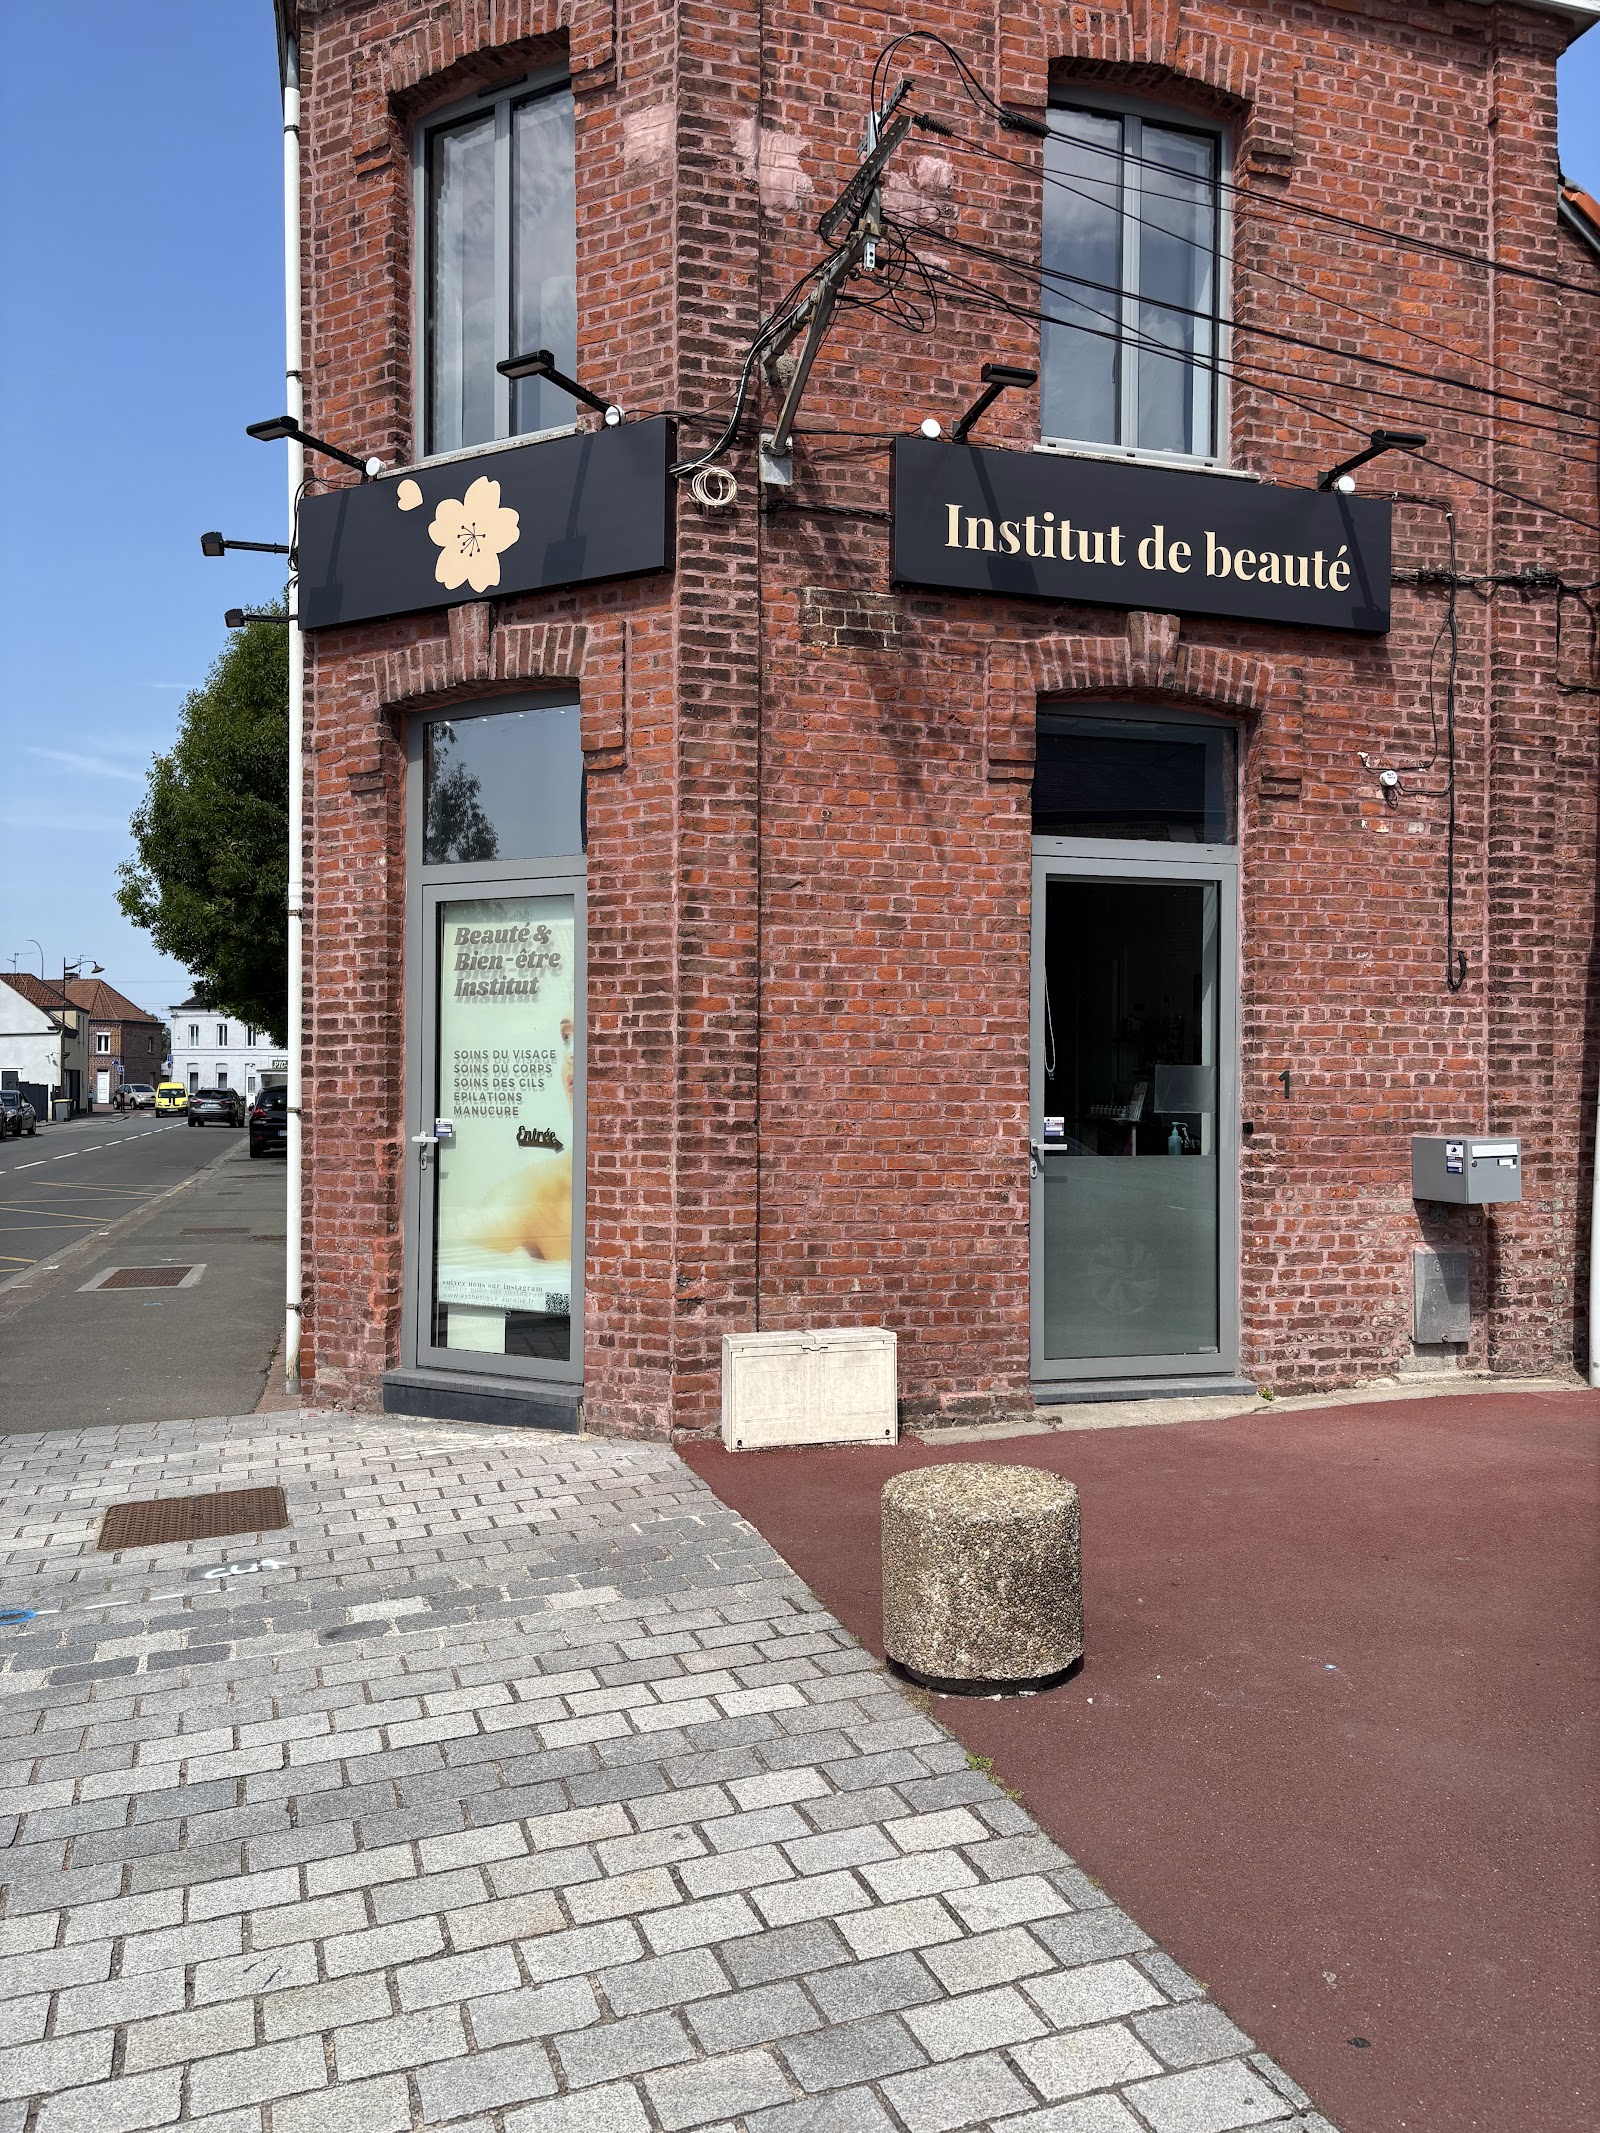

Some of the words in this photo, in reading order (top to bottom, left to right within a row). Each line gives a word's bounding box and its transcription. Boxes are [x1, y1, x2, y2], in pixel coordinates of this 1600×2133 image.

[944, 503, 1127, 567] Institut
[1138, 524, 1192, 574] de
[1205, 530, 1352, 593] beauté
[453, 922, 531, 946] Beauté
[533, 924, 553, 945] &
[453, 948, 562, 972] Bien-être
[453, 975, 540, 997] Institut
[453, 1050, 489, 1060] SOINS
[492, 1050, 509, 1060] DU
[512, 1050, 557, 1060] VISAGE
[453, 1064, 489, 1074] SOINS
[492, 1064, 509, 1074] DU
[512, 1064, 553, 1074] CORPS
[453, 1078, 489, 1088] SOINS
[492, 1078, 515, 1088] DES
[518, 1078, 545, 1088] CILS
[453, 1092, 523, 1102] EPILATIONS
[453, 1106, 519, 1116] MANUCURE
[516, 1125, 557, 1143] Entrée
[442, 1279, 466, 1287] suivez
[468, 1281, 486, 1289] nous
[488, 1282, 501, 1290] sur
[503, 1283, 543, 1293] instagram
